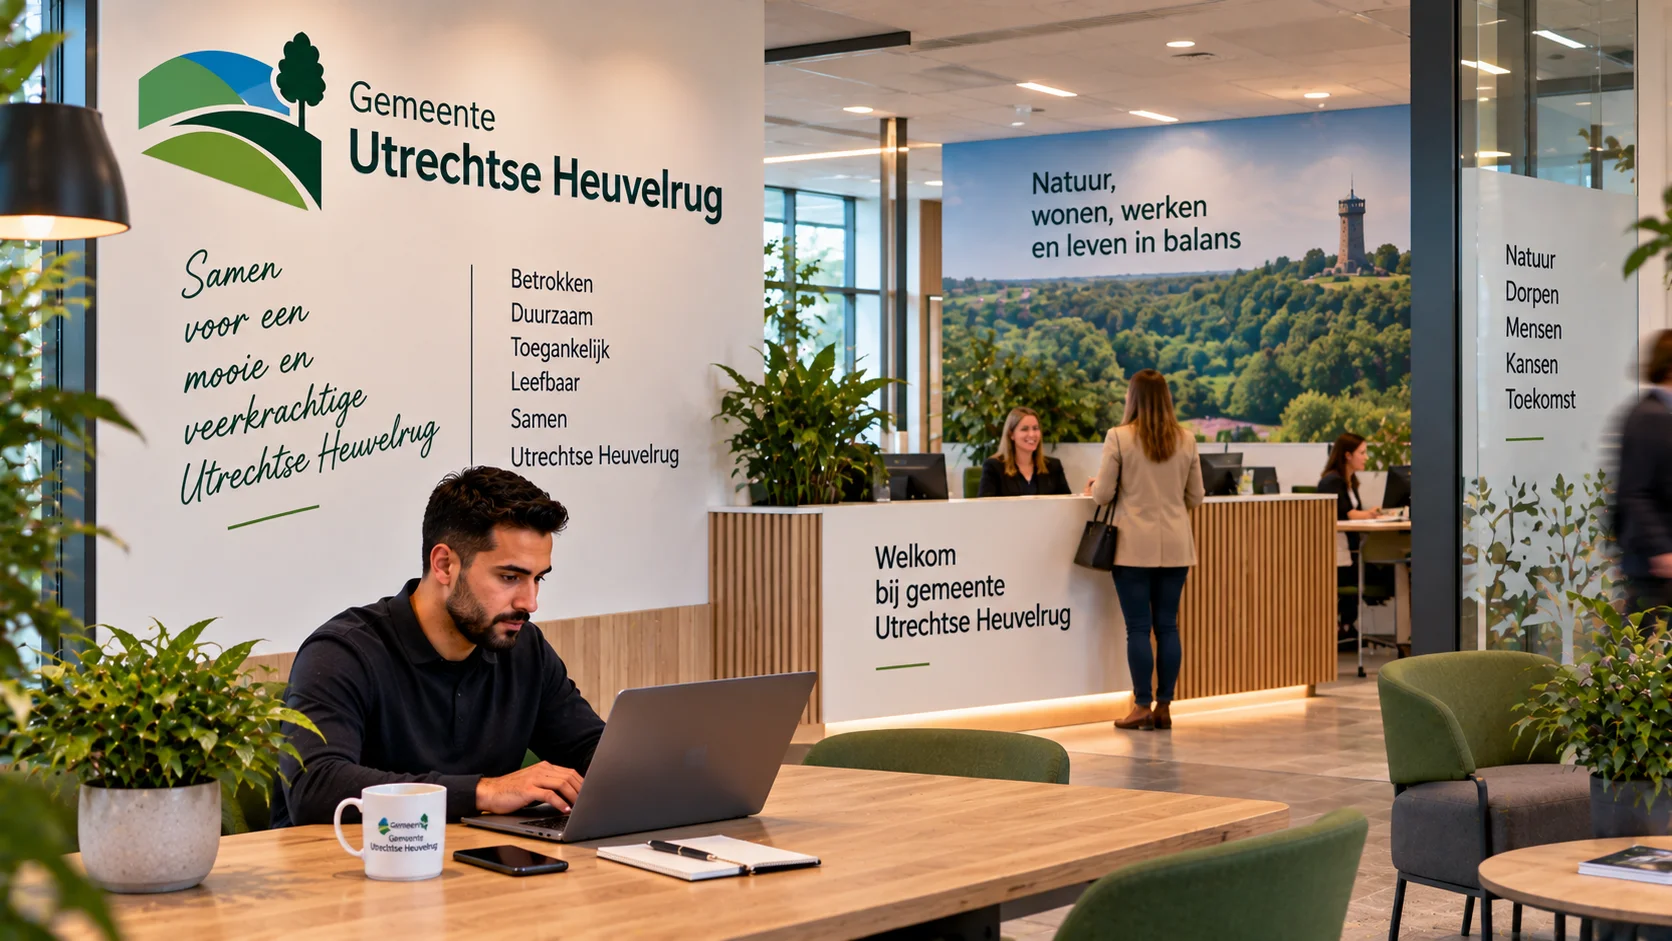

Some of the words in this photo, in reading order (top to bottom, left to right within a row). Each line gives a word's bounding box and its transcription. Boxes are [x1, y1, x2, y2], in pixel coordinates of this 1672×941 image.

[350, 81, 495, 131] Gemeente
[350, 128, 541, 194] Utrechtse
[554, 155, 722, 225] Heuvelrug
[1033, 171, 1115, 194] Natuur,
[1031, 206, 1113, 226] wonen,
[1121, 195, 1206, 221] werken
[1032, 241, 1059, 258] en
[1068, 233, 1126, 257] leven
[1136, 230, 1155, 253] in
[1164, 227, 1241, 252] balans
[1506, 244, 1556, 269] Natuur
[181, 249, 282, 299] Samen
[512, 268, 593, 293] Betrokken
[1506, 280, 1559, 308] Dorpen
[185, 314, 249, 343] voor
[261, 306, 309, 329] een
[512, 302, 592, 326] Duurzaam
[1506, 316, 1561, 339] Mensen
[511, 337, 610, 364] Toegankelijk
[1507, 352, 1558, 374] Kansen
[184, 354, 269, 393] mooie
[280, 352, 314, 373] en
[512, 371, 580, 392] Leefbaar
[1505, 387, 1576, 409] Toekomst
[185, 383, 367, 445] veerkrachtige
[511, 408, 567, 429] Samen
[181, 445, 310, 505] Utrechtse
[318, 414, 440, 473] Heuvelrug
[512, 445, 593, 467] Utrechtse
[599, 443, 679, 469] Heuvelrug
[875, 543, 956, 569] Welkom
[876, 579, 899, 609] bij
[906, 575, 1005, 608] gemeente
[876, 611, 970, 639] Utrechtse
[977, 603, 1070, 631] Heuvelrug
